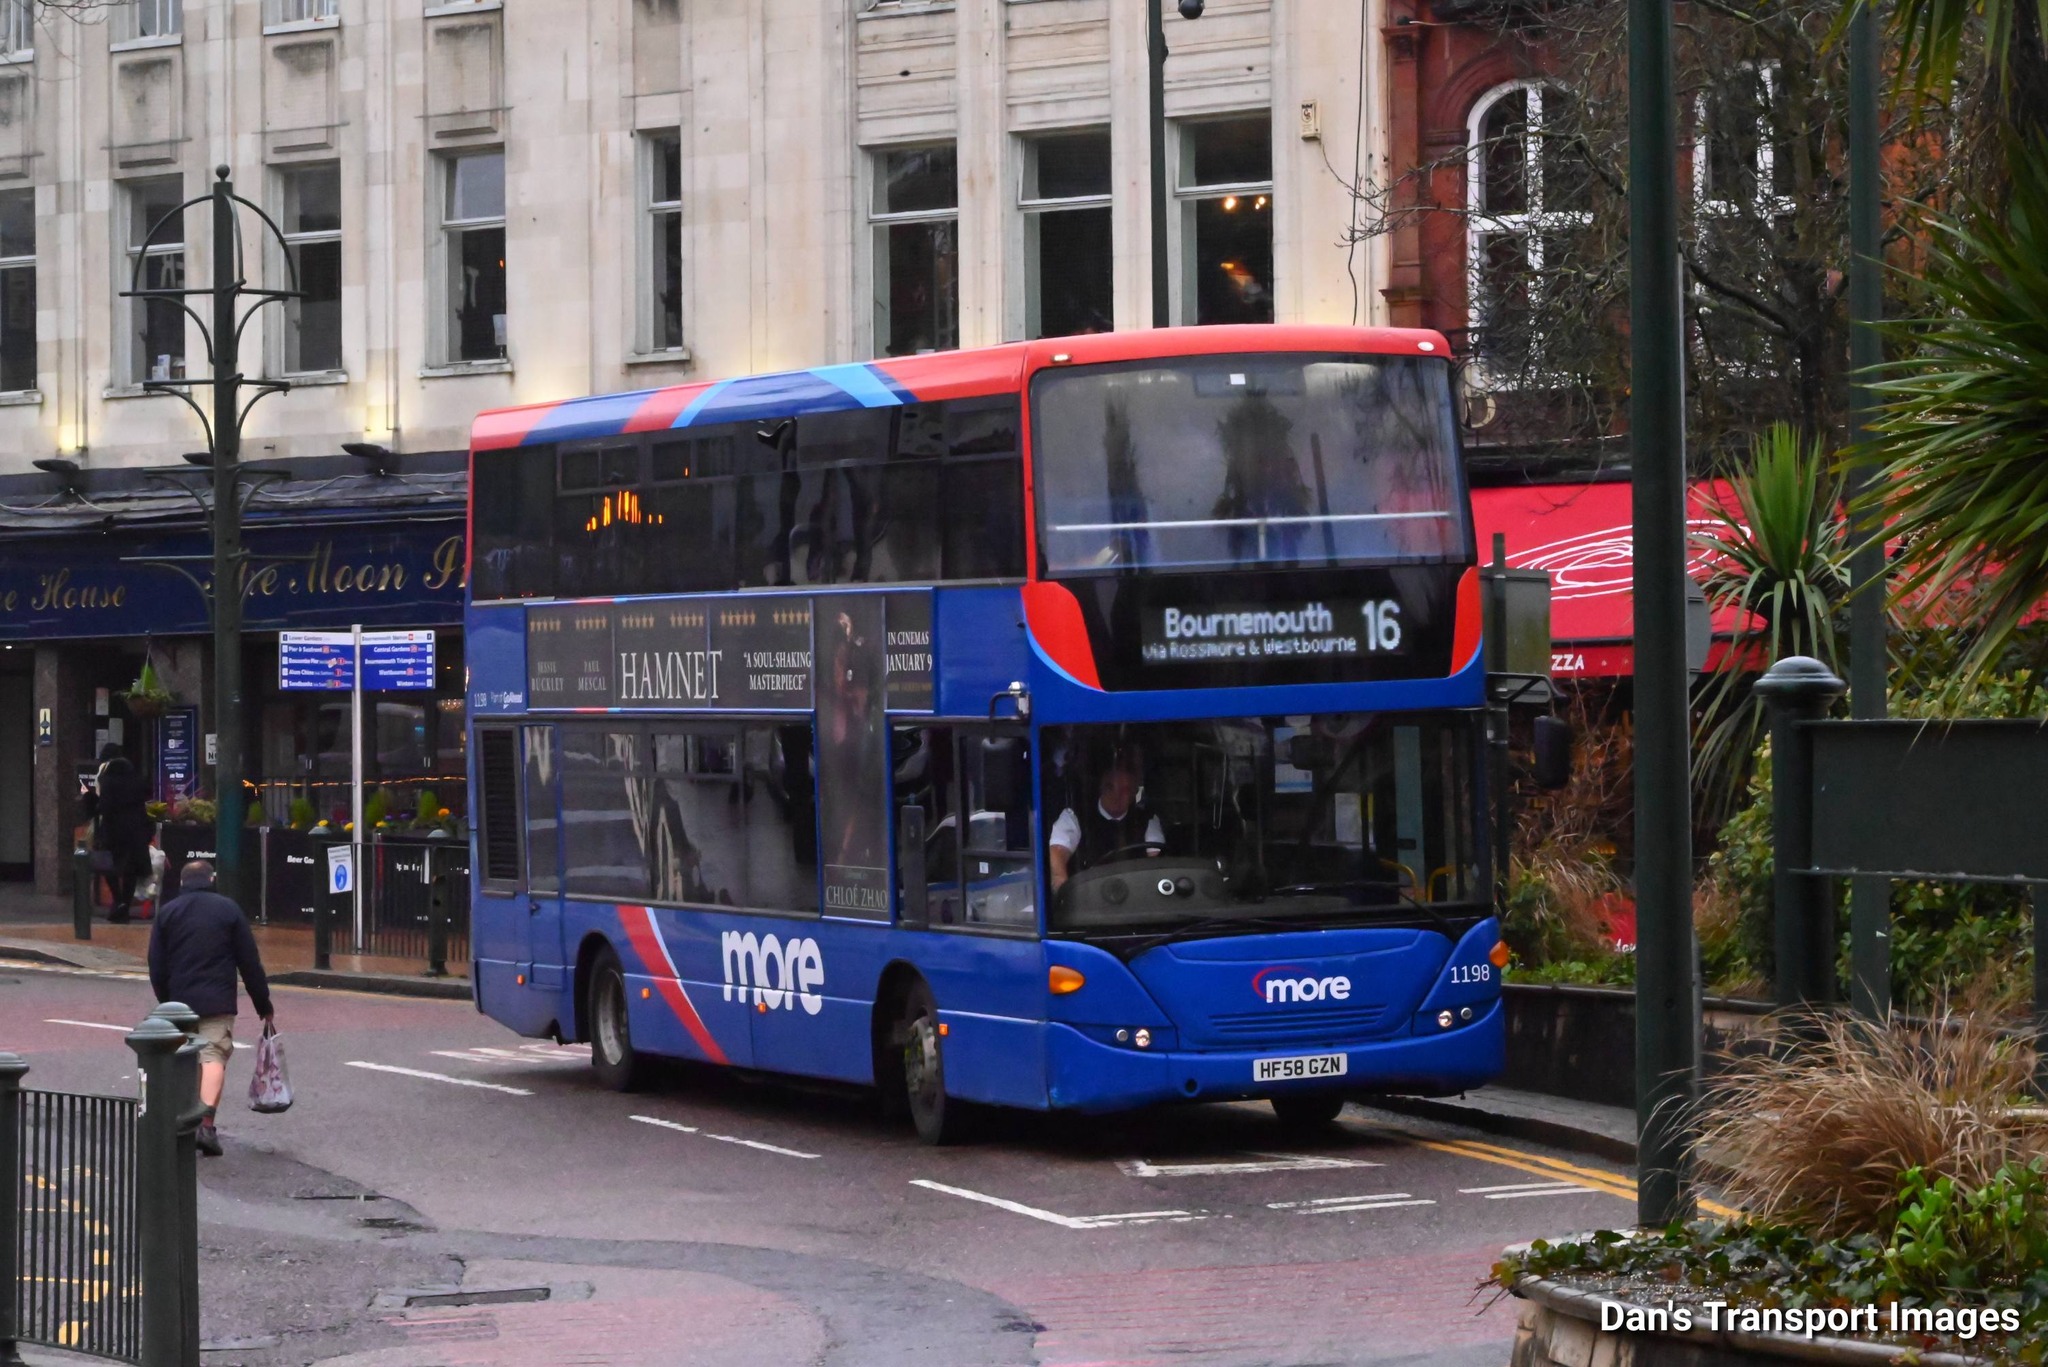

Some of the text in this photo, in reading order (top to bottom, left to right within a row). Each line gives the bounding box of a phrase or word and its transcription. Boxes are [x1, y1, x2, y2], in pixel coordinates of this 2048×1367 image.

[31, 567, 125, 610] House
[1165, 600, 1401, 650] Bournemouth 16
[887, 631, 929, 646] IN CINEMAS
[1142, 636, 1356, 660] via Rossmore & Westbourne
[584, 660, 600, 673] PAUL
[621, 650, 722, 699] HAMNET
[885, 653, 933, 676] JANUARY 9
[531, 678, 564, 691] BUCKLEY
[578, 677, 606, 691] MESCAL
[287, 855, 302, 864] Beer
[826, 884, 888, 909] CHLOÉ ZHAO
[722, 930, 825, 1016] more
[1450, 964, 1490, 984] 1198
[1266, 976, 1351, 1003] more
[1260, 1056, 1341, 1079] HF58 GZN
